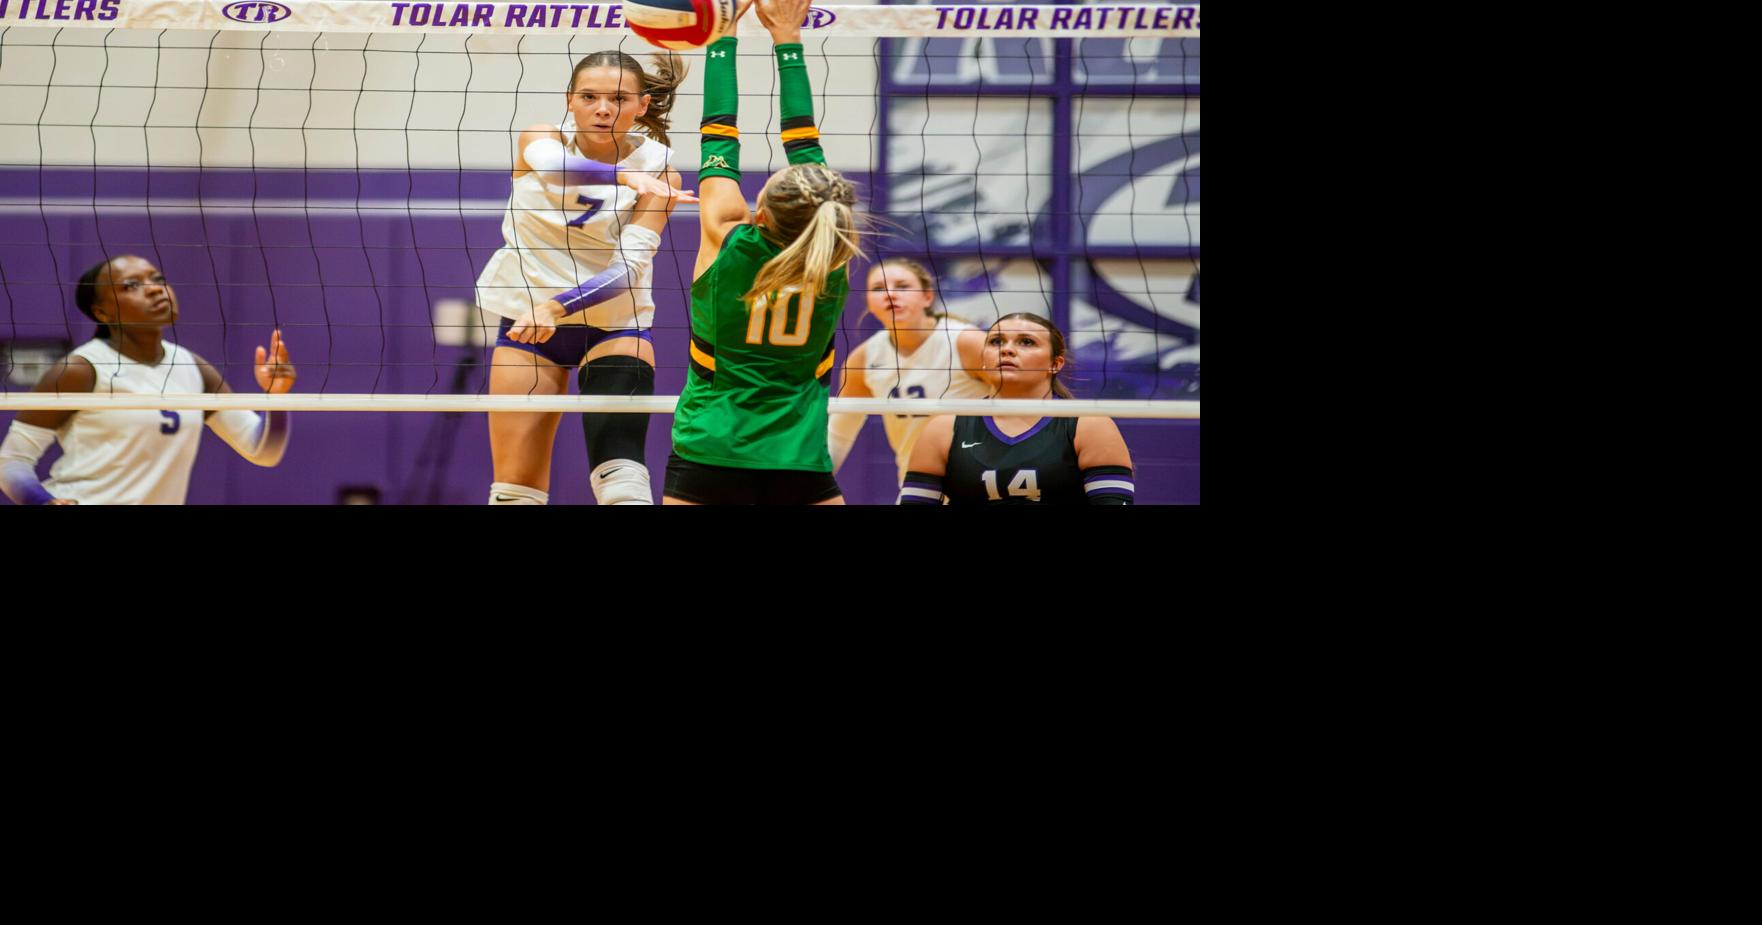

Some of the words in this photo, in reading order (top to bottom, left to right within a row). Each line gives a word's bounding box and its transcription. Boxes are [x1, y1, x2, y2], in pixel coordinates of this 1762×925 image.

[391, 3, 495, 27] TOLAR
[504, 4, 630, 28] RATTLE
[936, 7, 1039, 30] TOLAR
[1050, 7, 1200, 30] RATTLER
[566, 194, 605, 230] 7
[745, 282, 817, 347] 10
[981, 469, 1042, 502] 14
